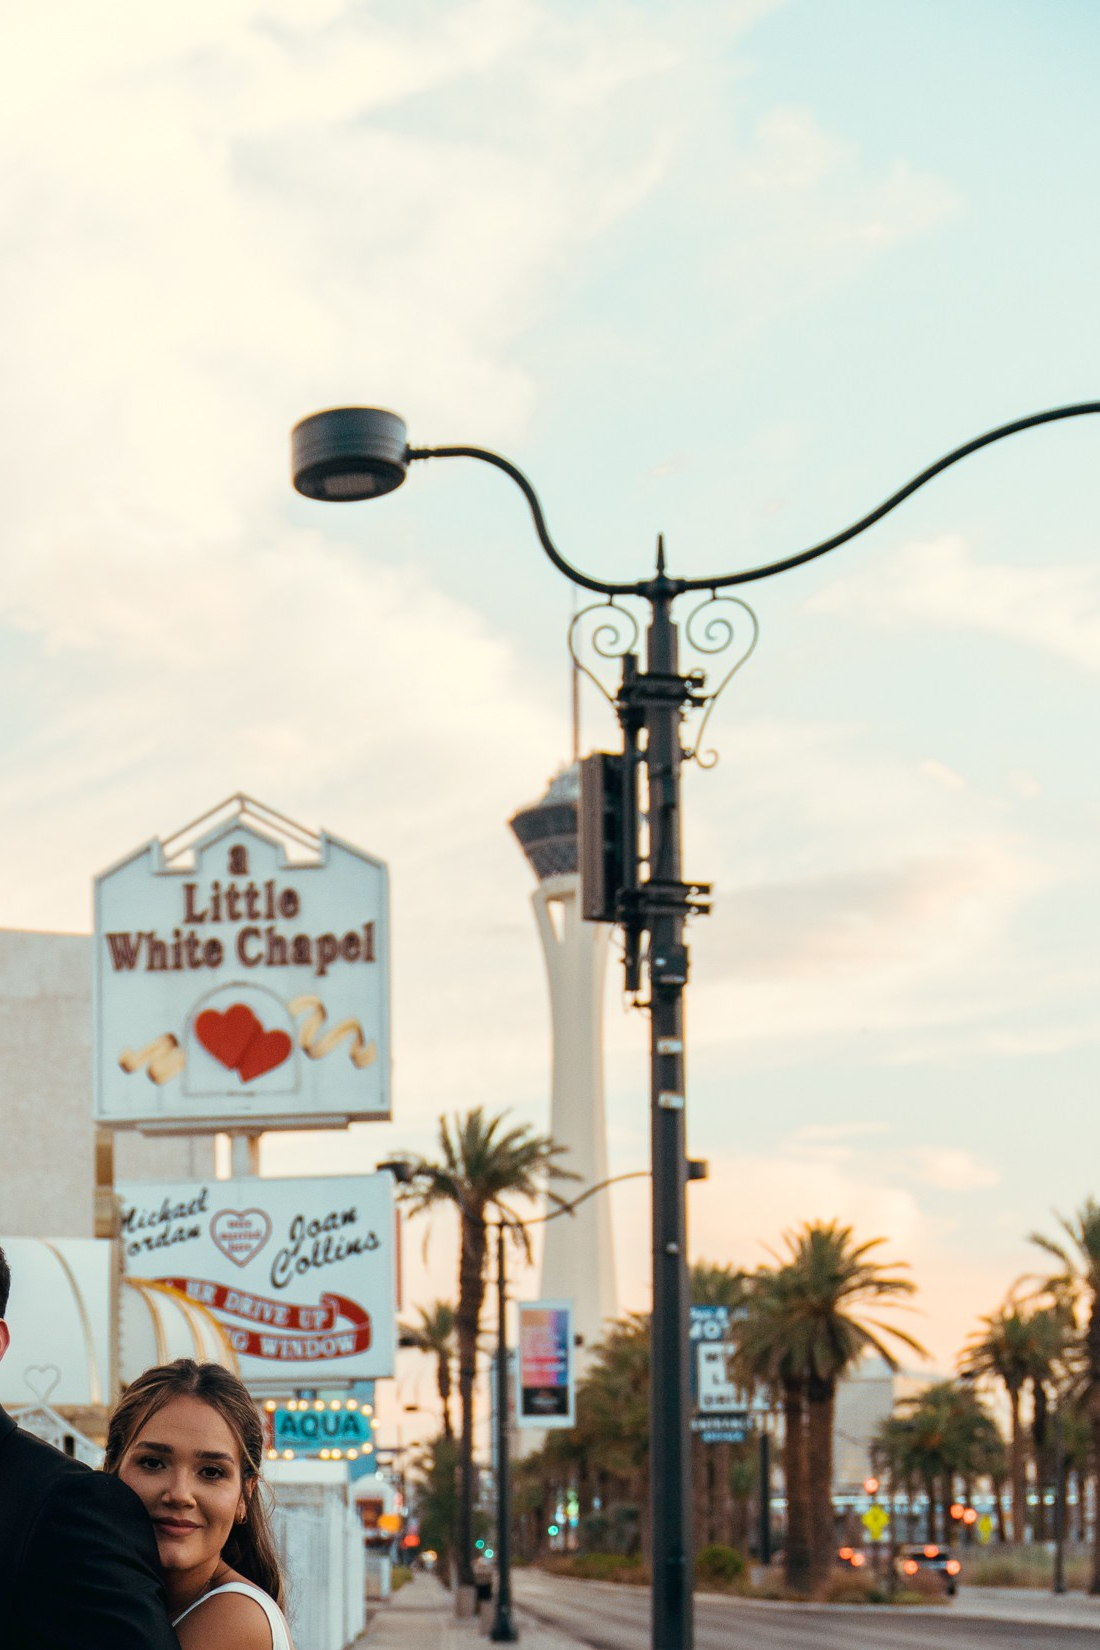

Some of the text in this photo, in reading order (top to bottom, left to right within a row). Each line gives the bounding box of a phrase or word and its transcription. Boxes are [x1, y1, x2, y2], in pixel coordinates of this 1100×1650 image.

[182, 878, 301, 925] Little
[106, 920, 376, 977] White Chapel
[126, 1225, 201, 1257] ordan
[289, 1205, 357, 1257] Joan
[270, 1230, 381, 1290] Collins
[223, 1290, 290, 1326] DRIVE
[298, 1309, 329, 1329] UP
[259, 1333, 357, 1356] WINDOW
[278, 1412, 361, 1438] AQUA
